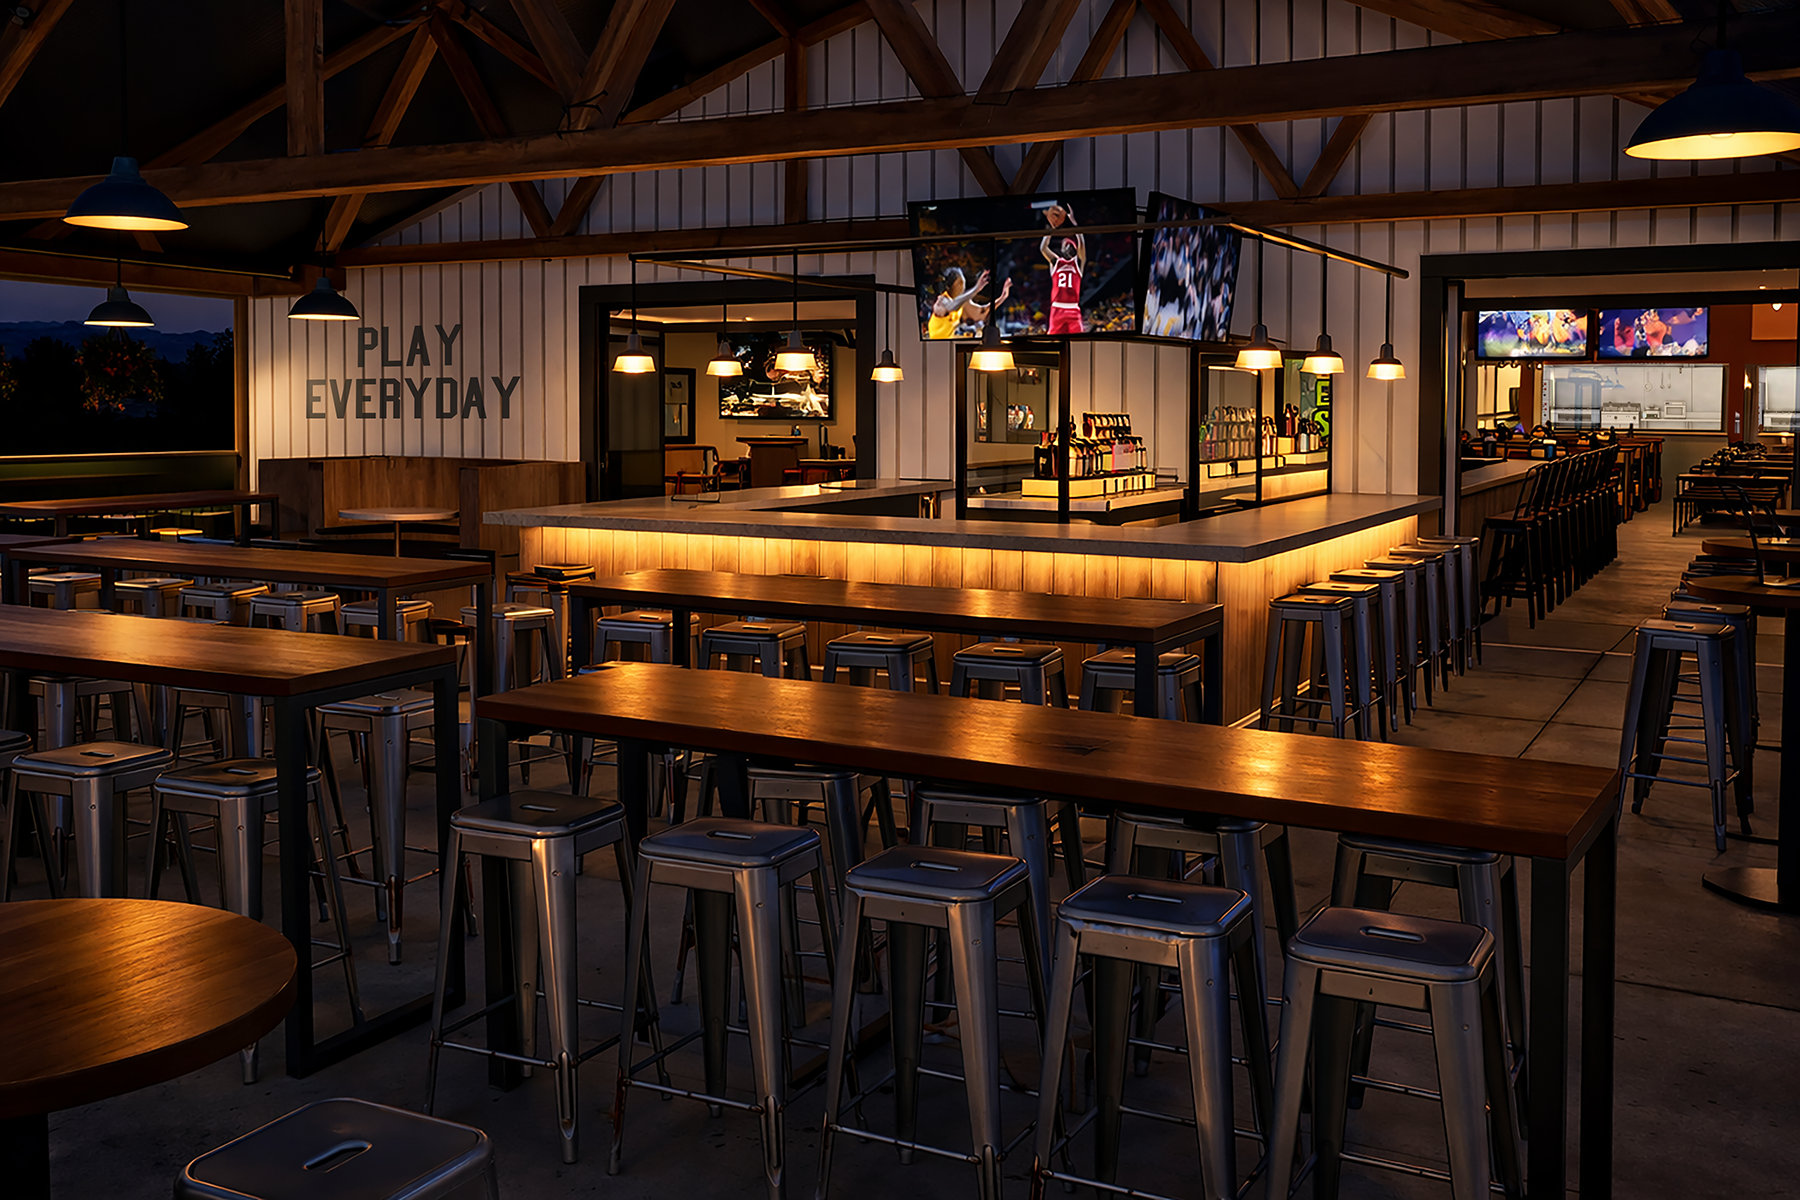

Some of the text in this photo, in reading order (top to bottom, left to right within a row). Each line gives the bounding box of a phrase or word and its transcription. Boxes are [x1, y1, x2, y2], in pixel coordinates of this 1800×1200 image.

[1058, 272, 1073, 288] 21
[358, 324, 461, 367] PLAY
[306, 376, 520, 419] EVERYDAY
